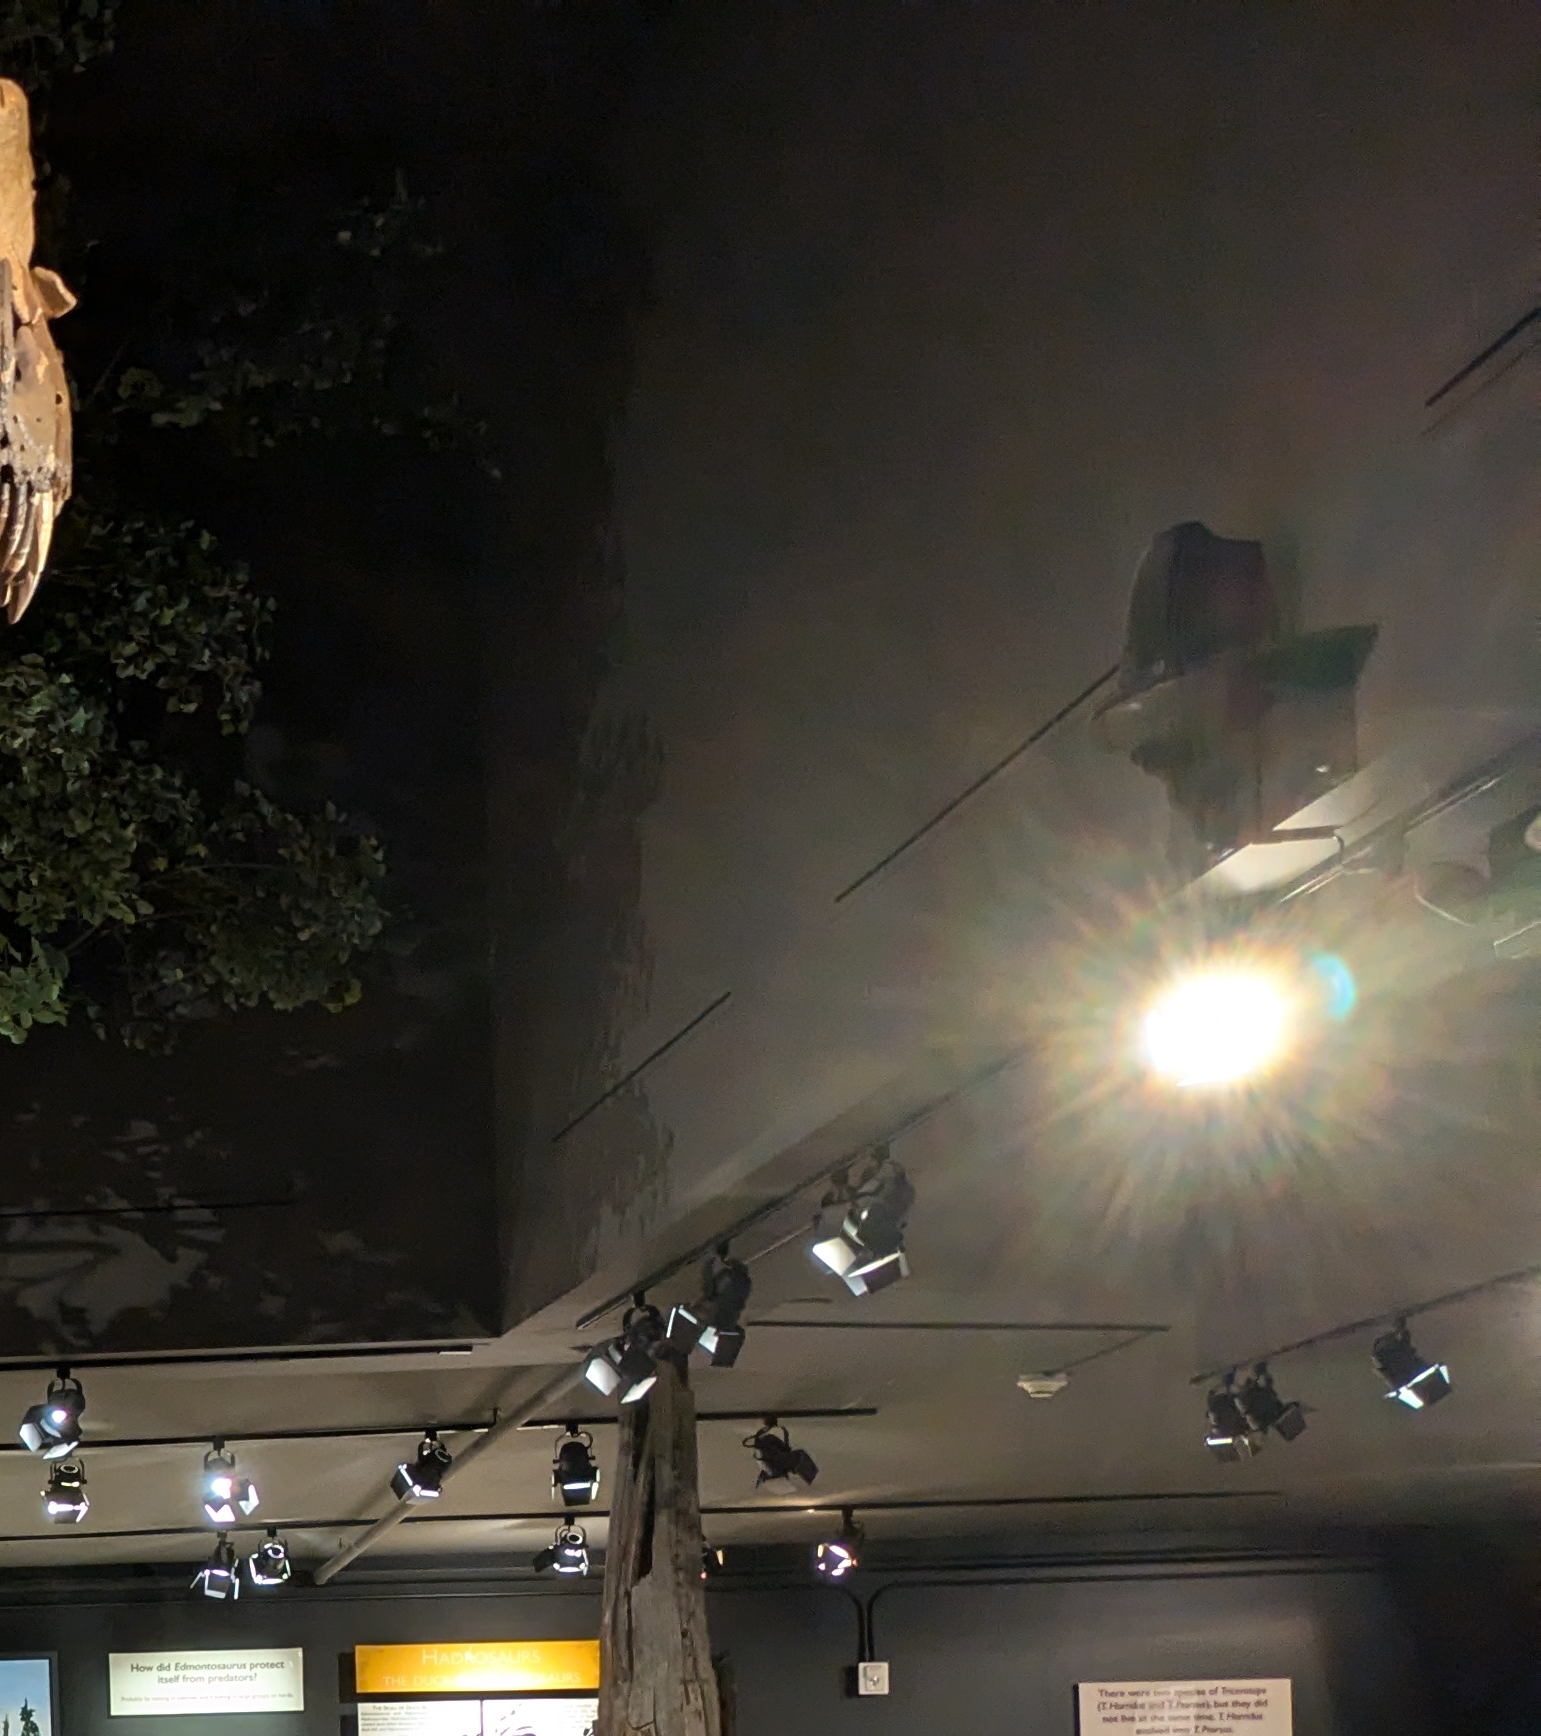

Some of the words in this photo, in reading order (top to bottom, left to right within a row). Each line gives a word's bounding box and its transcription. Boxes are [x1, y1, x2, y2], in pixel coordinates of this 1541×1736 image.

[421, 1648, 541, 1665] HADROSAURS
[130, 1663, 153, 1673] How
[156, 1663, 171, 1672] did
[174, 1661, 247, 1671] Edmontosaurus
[249, 1661, 285, 1672] protect
[157, 1675, 180, 1684] itself
[182, 1674, 205, 1683] from
[208, 1673, 258, 1685] predators?
[382, 1676, 407, 1686] THE
